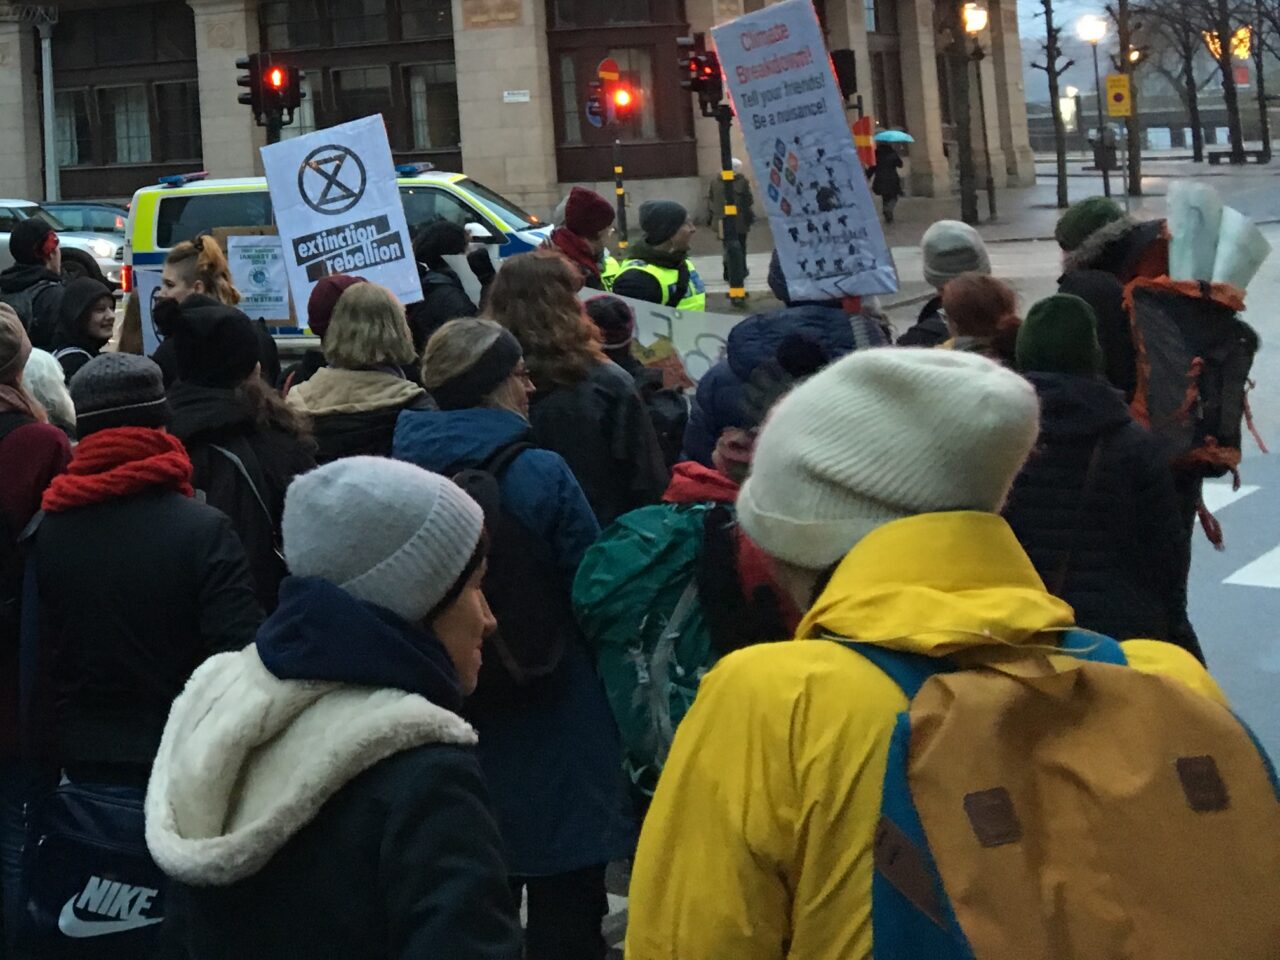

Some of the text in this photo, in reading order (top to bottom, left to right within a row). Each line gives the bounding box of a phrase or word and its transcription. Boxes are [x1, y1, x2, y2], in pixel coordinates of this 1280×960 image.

[741, 23, 790, 51] Climate
[741, 89, 760, 109] Tell
[761, 86, 783, 108] your
[752, 112, 768, 130] Be
[297, 224, 378, 258] extinction
[325, 242, 401, 277] rebellion
[76, 875, 159, 921] NIKE
